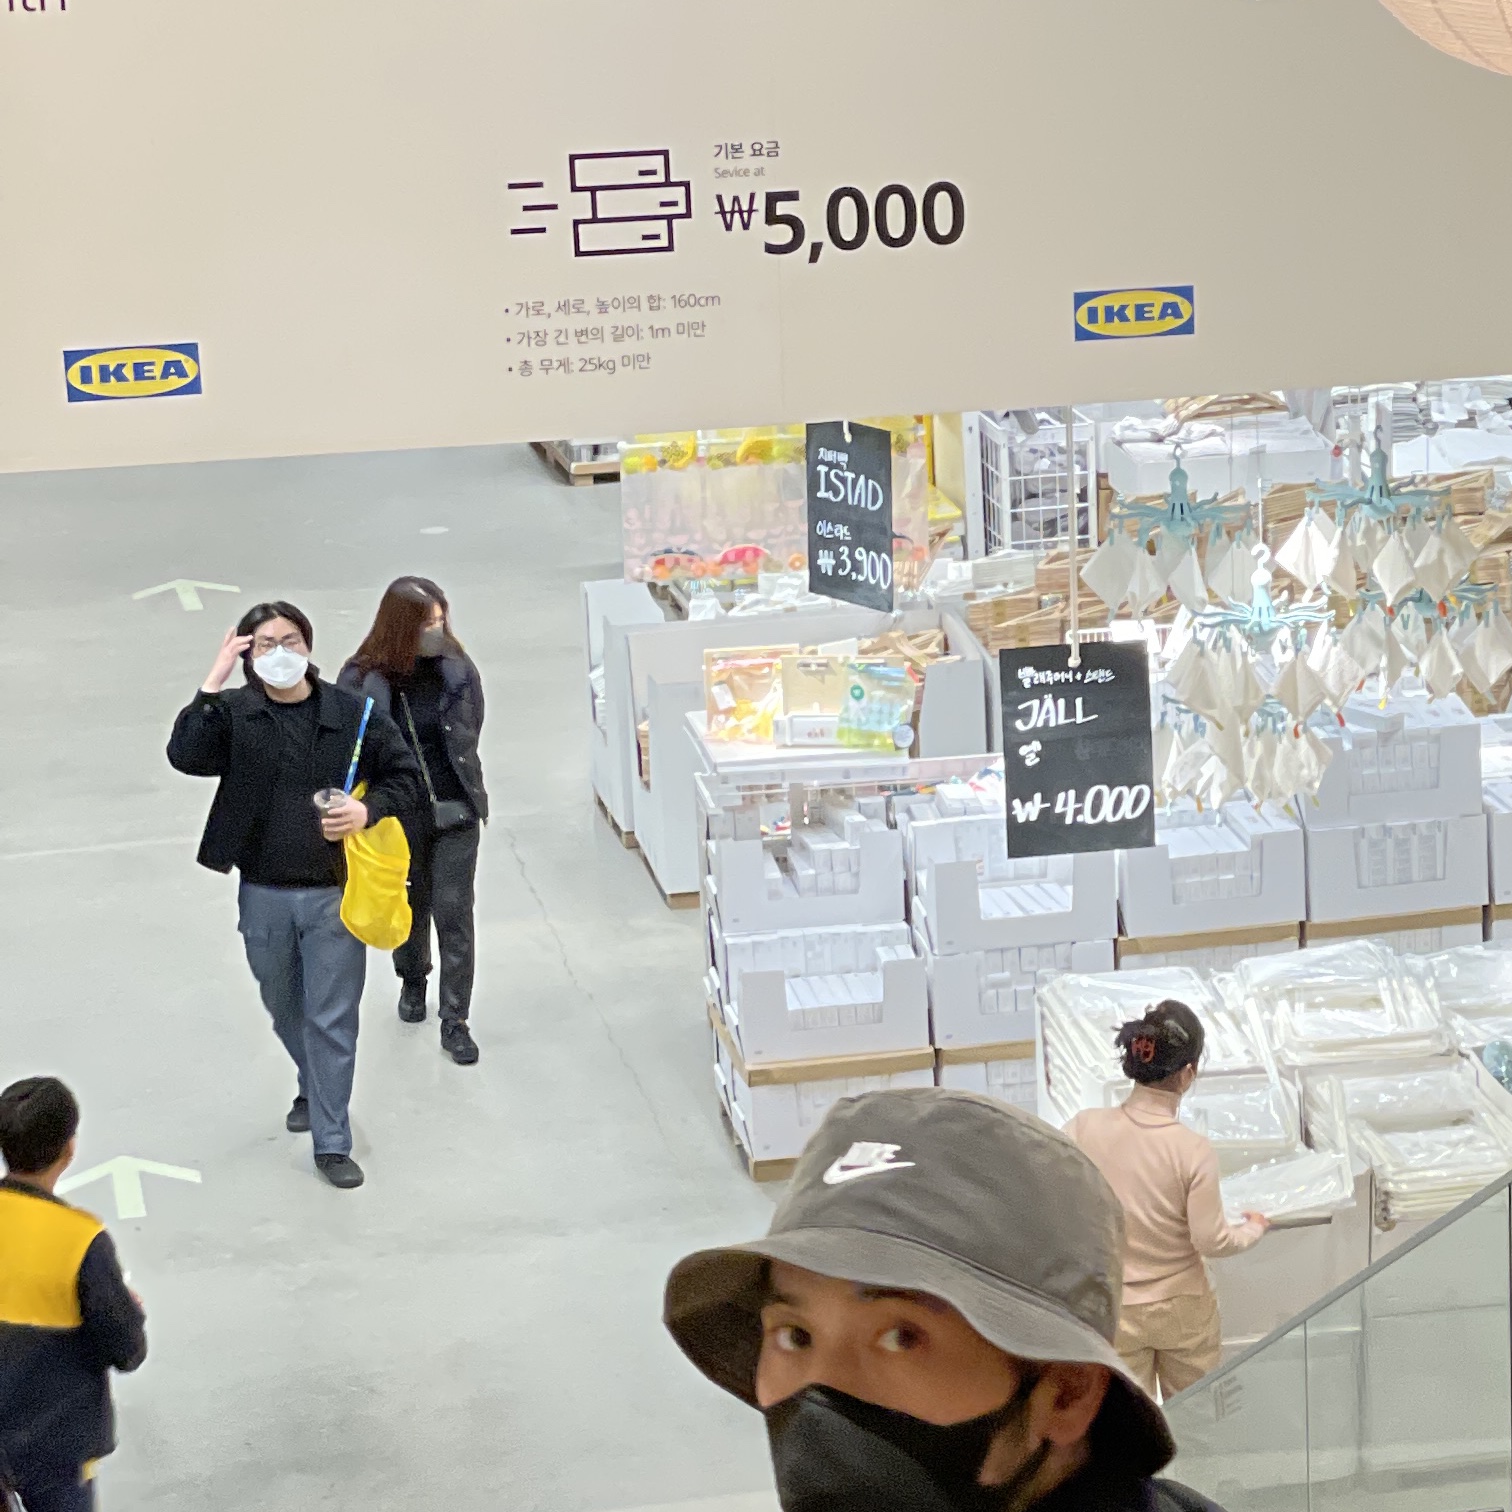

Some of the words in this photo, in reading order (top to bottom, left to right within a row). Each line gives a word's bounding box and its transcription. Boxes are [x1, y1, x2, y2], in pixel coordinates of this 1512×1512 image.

[714, 142, 744, 160] 기본
[750, 140, 781, 158] 요금
[753, 166, 766, 177] at
[714, 181, 965, 264] ₩5,000
[515, 300, 552, 318] 가로,
[555, 299, 591, 316] 세로,
[595, 294, 641, 315] 높이의
[670, 293, 721, 309] 160cm
[1087, 302, 1184, 325] IKEA
[517, 328, 549, 347] 가장
[554, 328, 569, 346] 긴
[574, 326, 605, 344] 변의
[610, 324, 644, 342] 길이:
[648, 325, 671, 339] 1m
[676, 320, 706, 338] 미만
[79, 359, 190, 385] IKEA
[518, 359, 533, 377] 총
[539, 357, 575, 376] 무게:
[578, 356, 616, 374] 25kg
[621, 352, 651, 371] 미만
[817, 465, 884, 511] ISTAD
[1015, 693, 1098, 731] JÄLL
